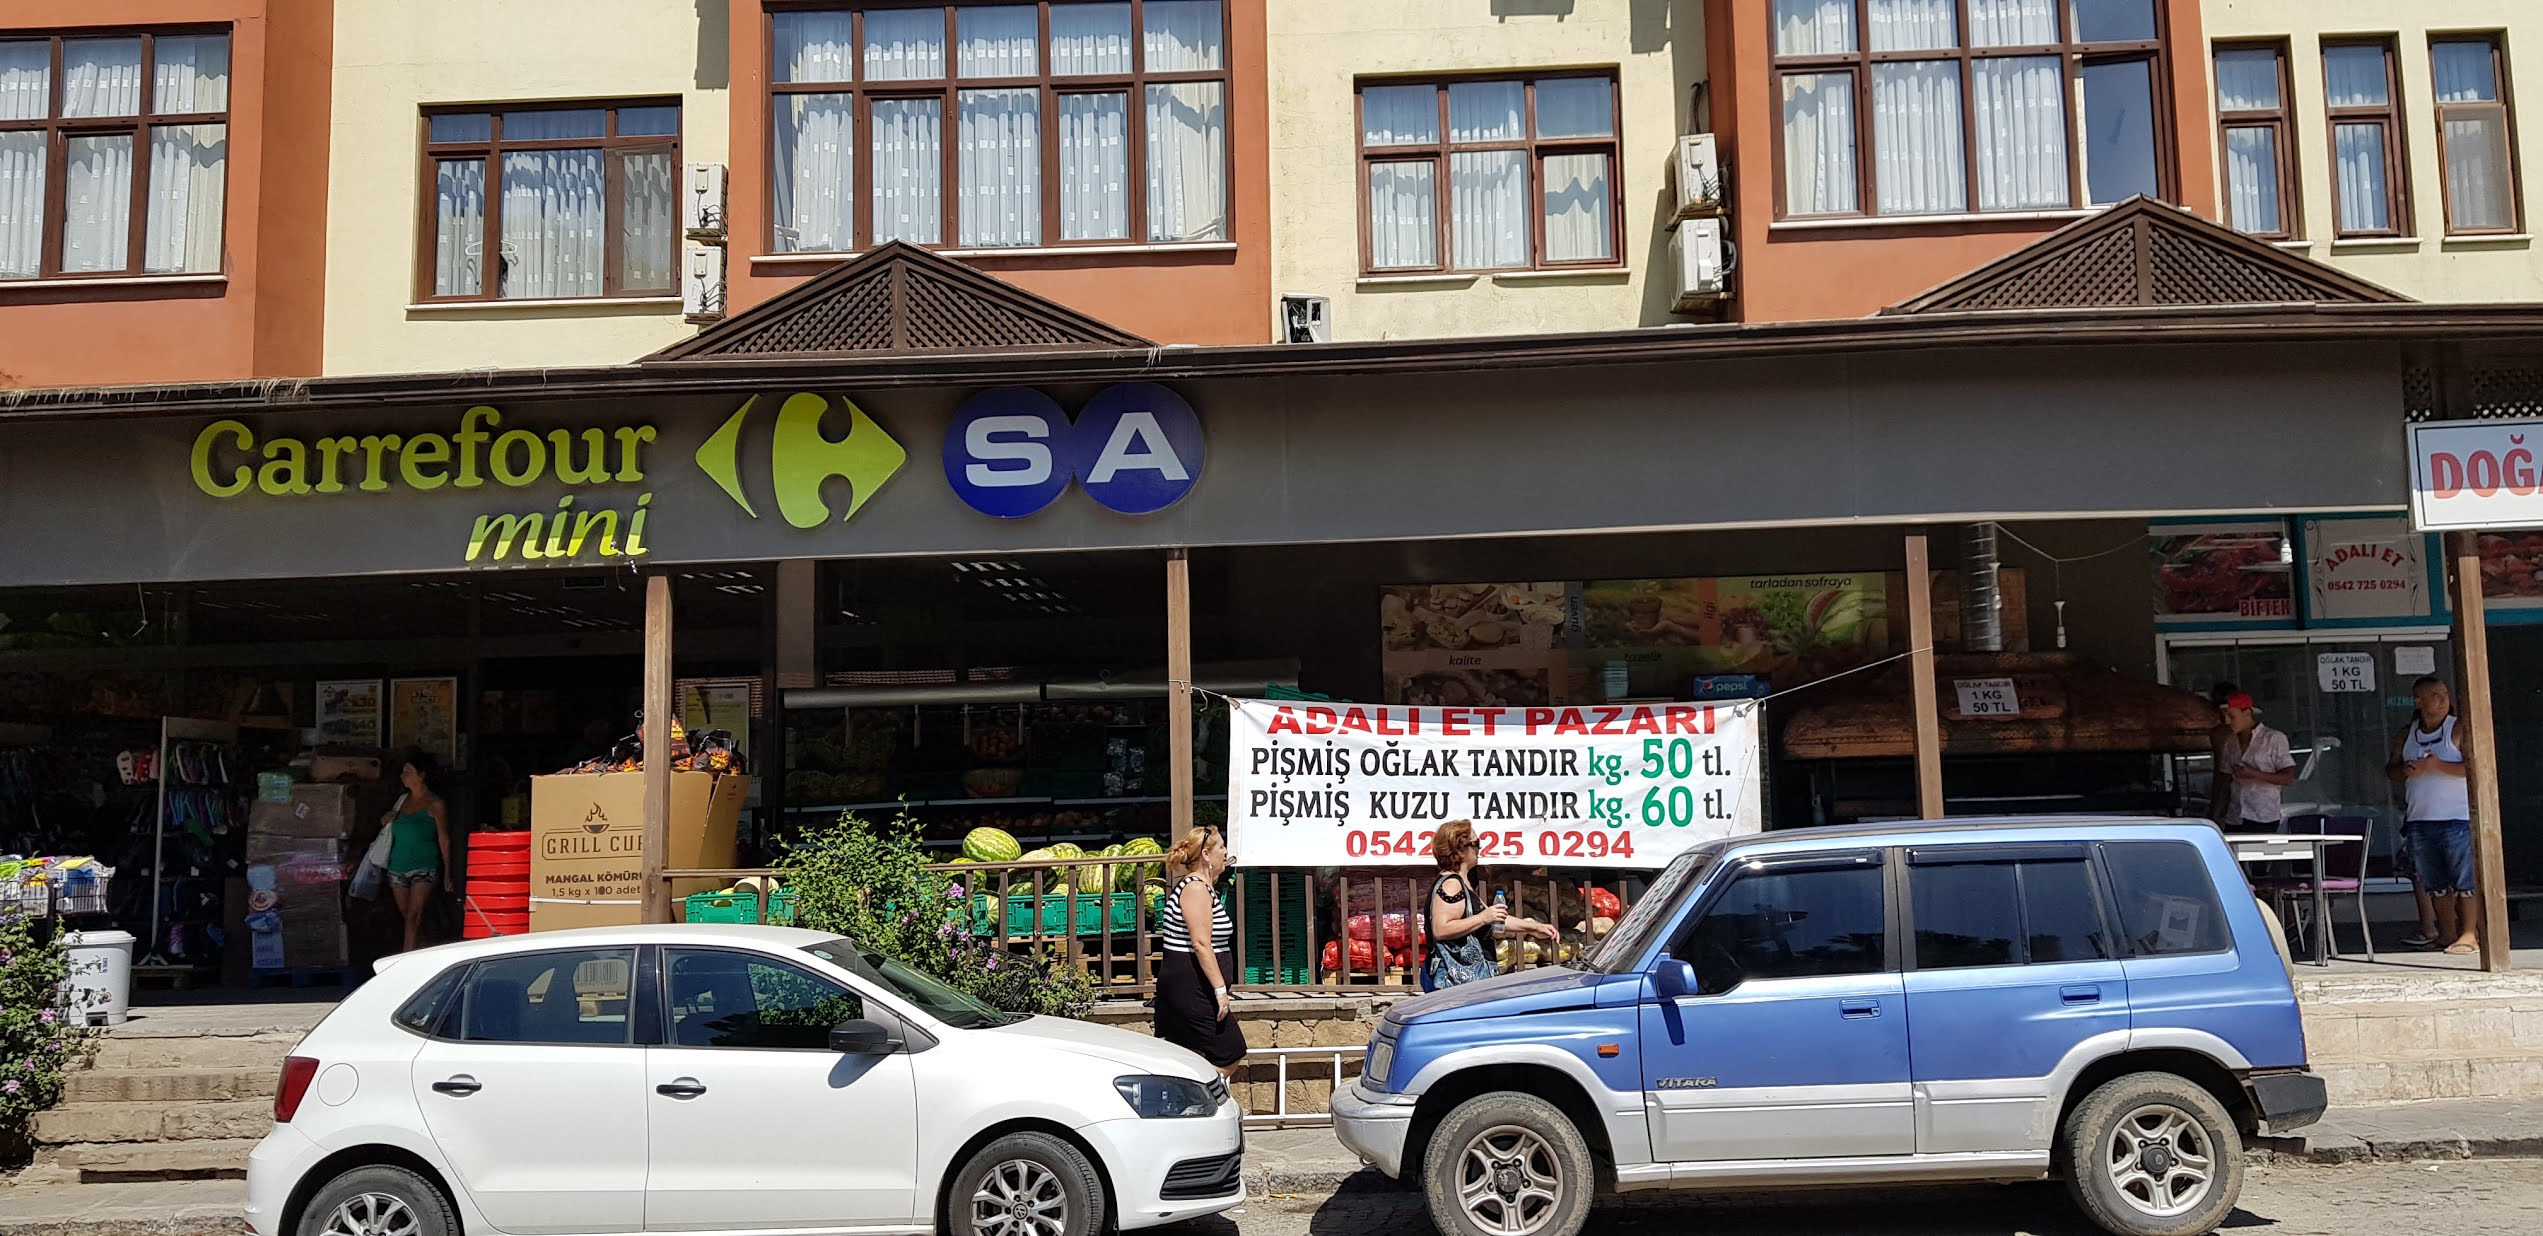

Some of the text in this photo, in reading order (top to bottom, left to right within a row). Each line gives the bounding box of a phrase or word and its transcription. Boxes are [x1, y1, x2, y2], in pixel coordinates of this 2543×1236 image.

[190, 405, 657, 497] Carrefour
[2430, 433, 2543, 499] DOĞ
[464, 492, 654, 561] mini
[2325, 543, 2405, 572] ADALI ET
[1750, 576, 1852, 589] tarladan sofraya
[2327, 579, 2406, 591] 0542 725 0294
[1570, 596, 1582, 633] güven
[1448, 655, 1482, 666] kalite
[2332, 667, 2361, 676] 1 KG
[1715, 681, 1748, 693] pepsi
[2331, 680, 2367, 690] 50 TL
[1971, 690, 2002, 700] 1 KG
[1973, 702, 2012, 712] 50 TL
[1266, 705, 1716, 736] ADALI ET PAZARI
[1251, 737, 1731, 786] PİŞMİŞ OĞLAK TANDIR kg. 50 tl.
[1249, 782, 1733, 829] PİŞMİŞ KUZU TANDIR kg. 60 tl.
[547, 836, 601, 854] GRILL
[1346, 830, 1635, 859] 0542 25 0294
[545, 870, 643, 884] MANGAL KÖMÜR
[552, 887, 565, 897] 1,5
[568, 886, 581, 898] kg
[585, 888, 591, 896] x
[616, 885, 641, 895] adet
[1656, 1076, 1718, 1088] VITARA
